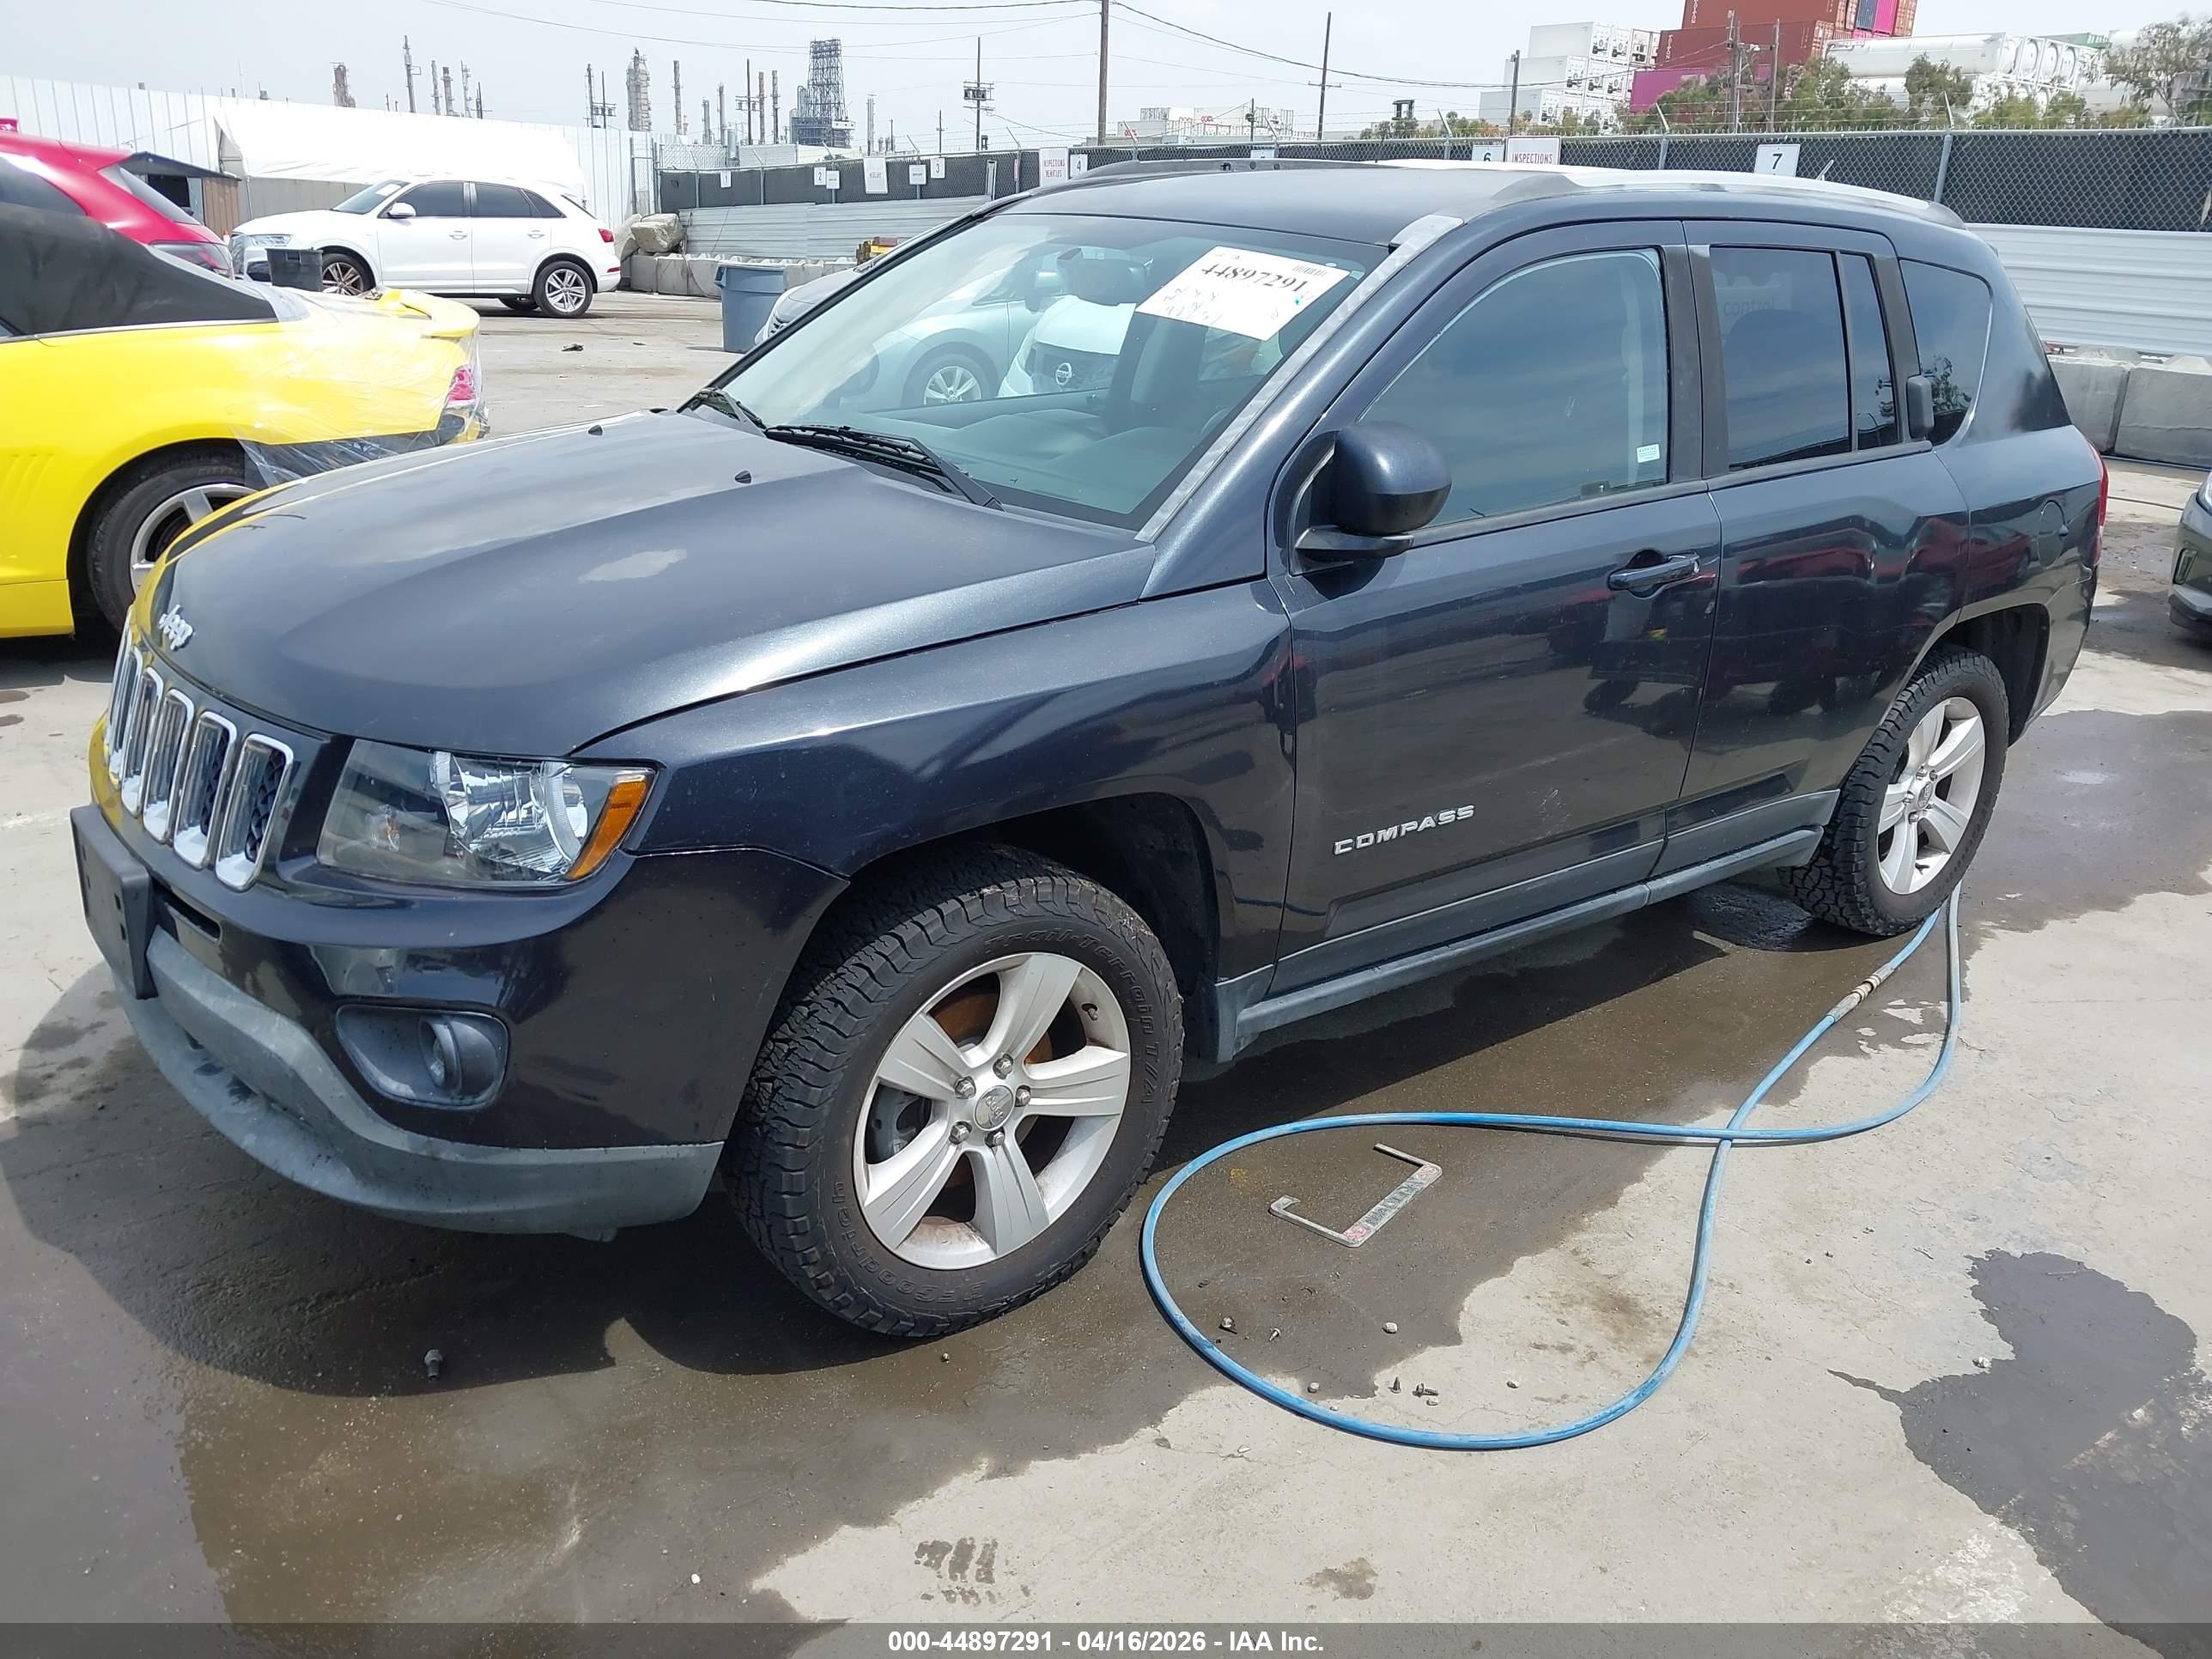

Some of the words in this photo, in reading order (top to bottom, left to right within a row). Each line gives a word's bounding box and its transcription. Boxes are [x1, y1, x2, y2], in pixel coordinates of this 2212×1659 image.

[1512, 152, 1553, 164] INSPECTIONS
[1771, 153, 1783, 170] 7
[935, 163, 940, 173] 3
[1076, 160, 1082, 172] 4
[817, 172, 823, 181] 2
[1201, 264, 1309, 292] 44897291
[1333, 804, 1475, 856] COMPASS
